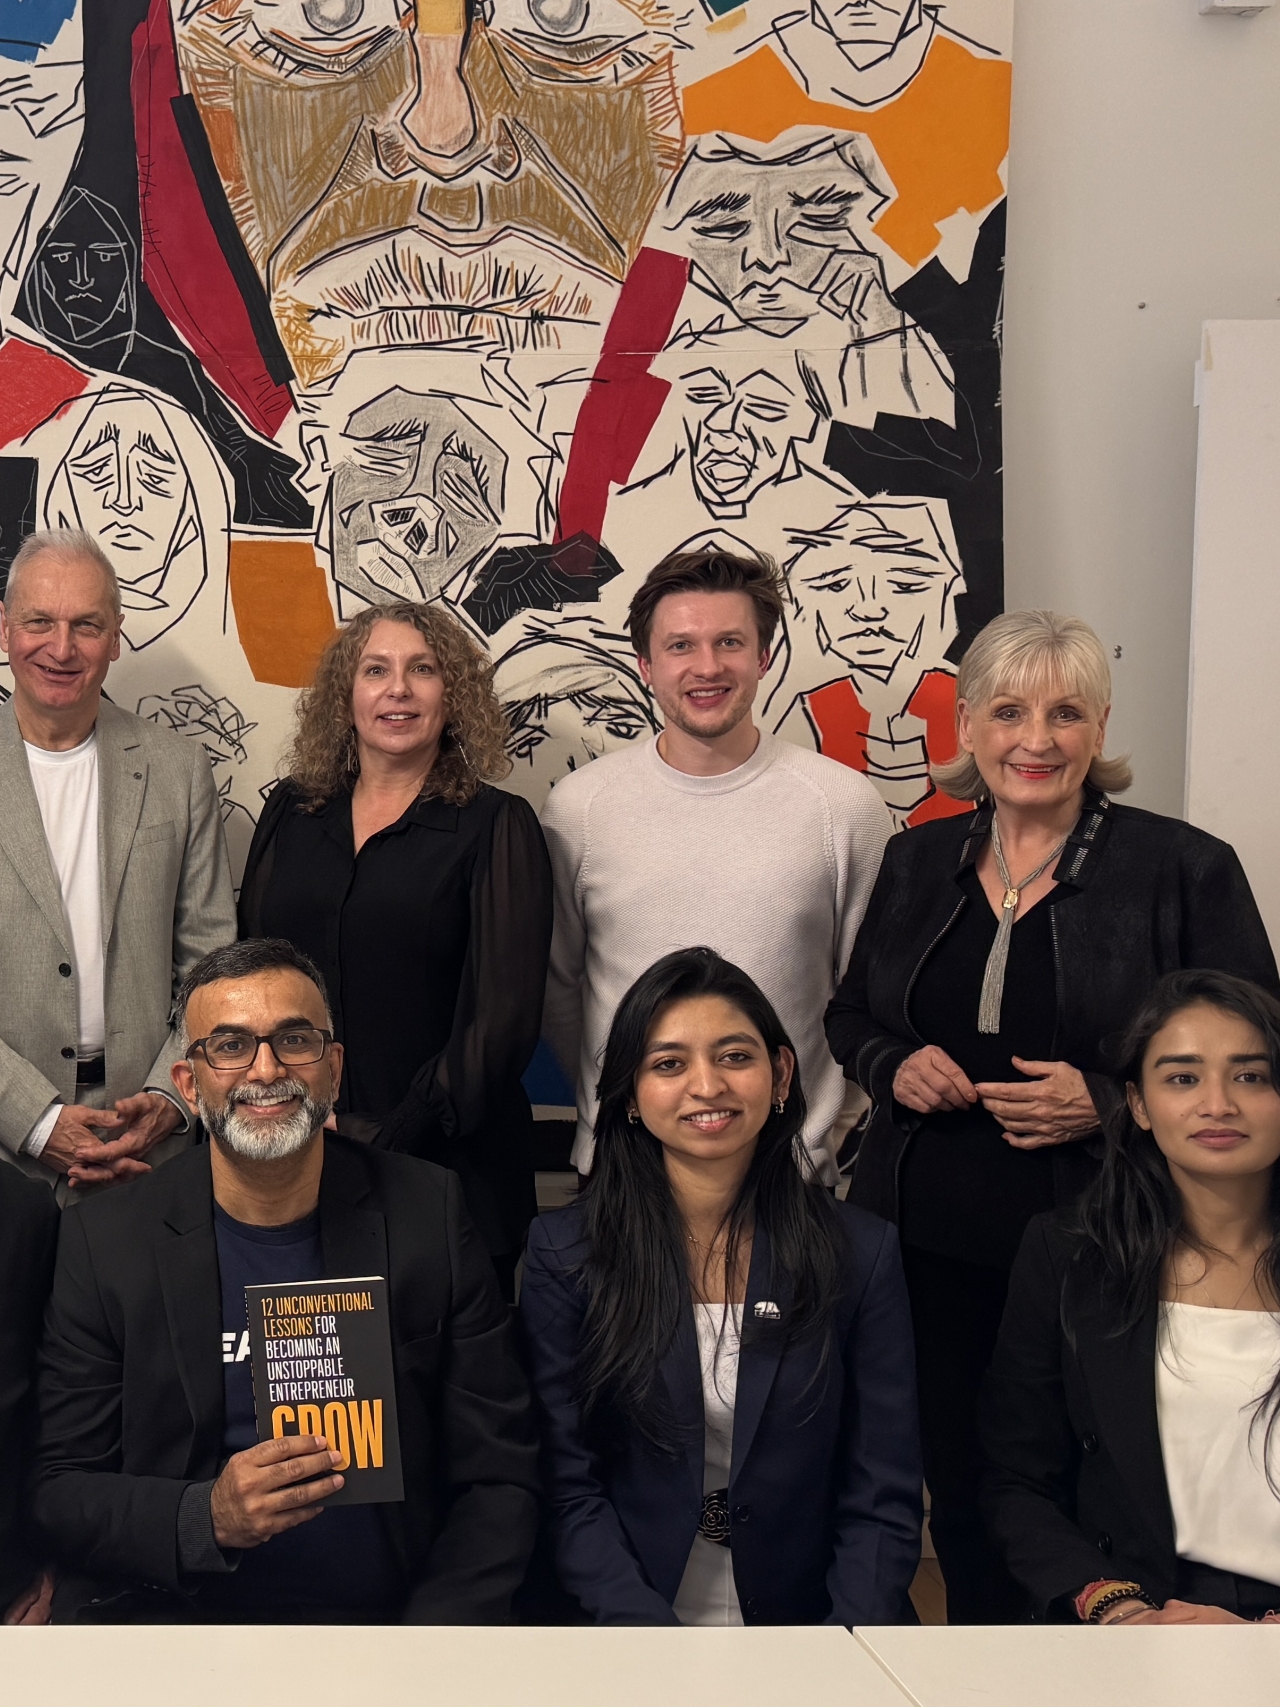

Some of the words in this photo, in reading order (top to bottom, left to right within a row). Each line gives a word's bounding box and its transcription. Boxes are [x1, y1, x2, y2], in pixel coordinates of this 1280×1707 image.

[260, 1298, 274, 1317] 12
[276, 1292, 375, 1316] UNCONVENTIONAL
[263, 1316, 313, 1338] LESSONS
[314, 1315, 337, 1335] FOR
[265, 1337, 323, 1359] BECOMING
[325, 1336, 341, 1356] AN
[266, 1357, 345, 1381] UNSTOPPABLE
[269, 1378, 355, 1402] ENTREPRENEUR
